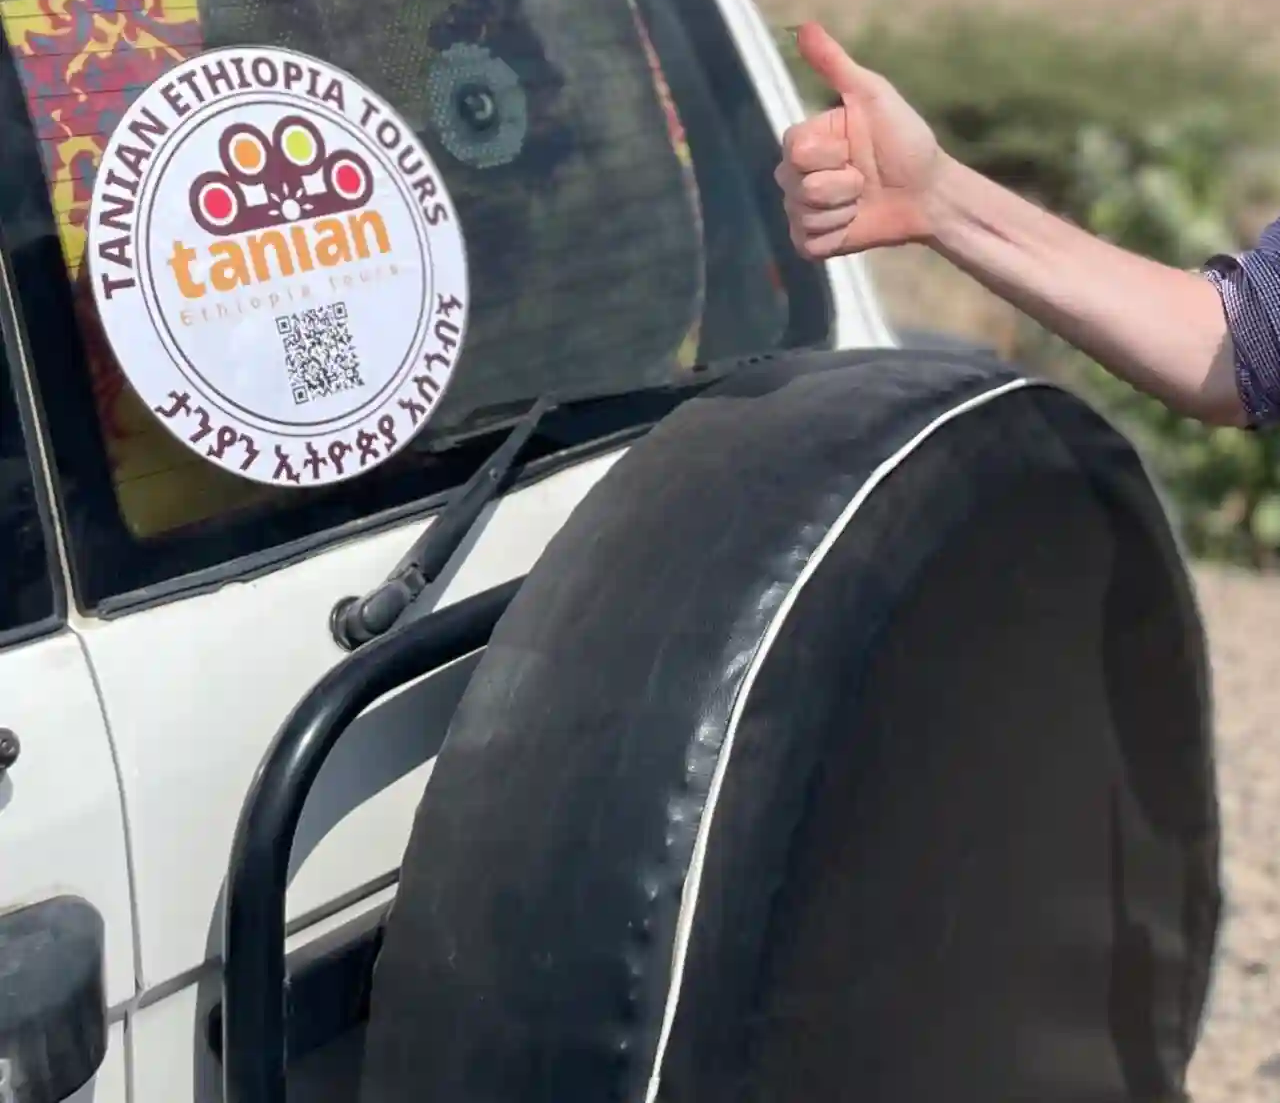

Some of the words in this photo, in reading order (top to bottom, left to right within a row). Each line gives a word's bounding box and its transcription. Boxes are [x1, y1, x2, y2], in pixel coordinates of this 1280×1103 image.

[98, 108, 169, 300] TANIAN
[161, 57, 345, 117] ETHIOPIA
[360, 99, 448, 227] TOURS
[167, 209, 392, 300] tanian
[154, 390, 260, 471] ታንያን
[272, 414, 398, 485] ኢትዮጵያ
